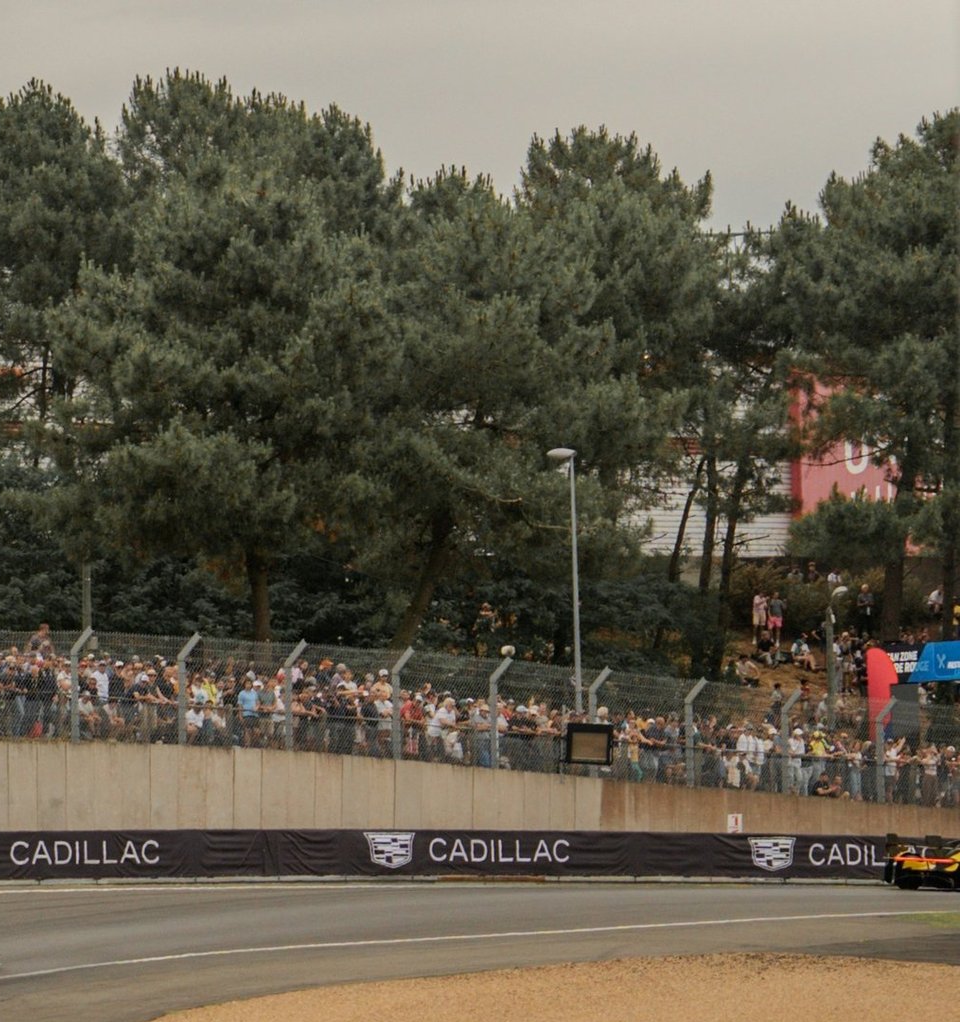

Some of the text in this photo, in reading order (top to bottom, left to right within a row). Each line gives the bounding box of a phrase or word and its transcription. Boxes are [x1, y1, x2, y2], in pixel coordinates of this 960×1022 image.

[900, 650, 918, 662] ZONE
[10, 839, 160, 866] CADILLAC
[428, 837, 570, 863] CADILLAC
[808, 843, 927, 867] CADIL
